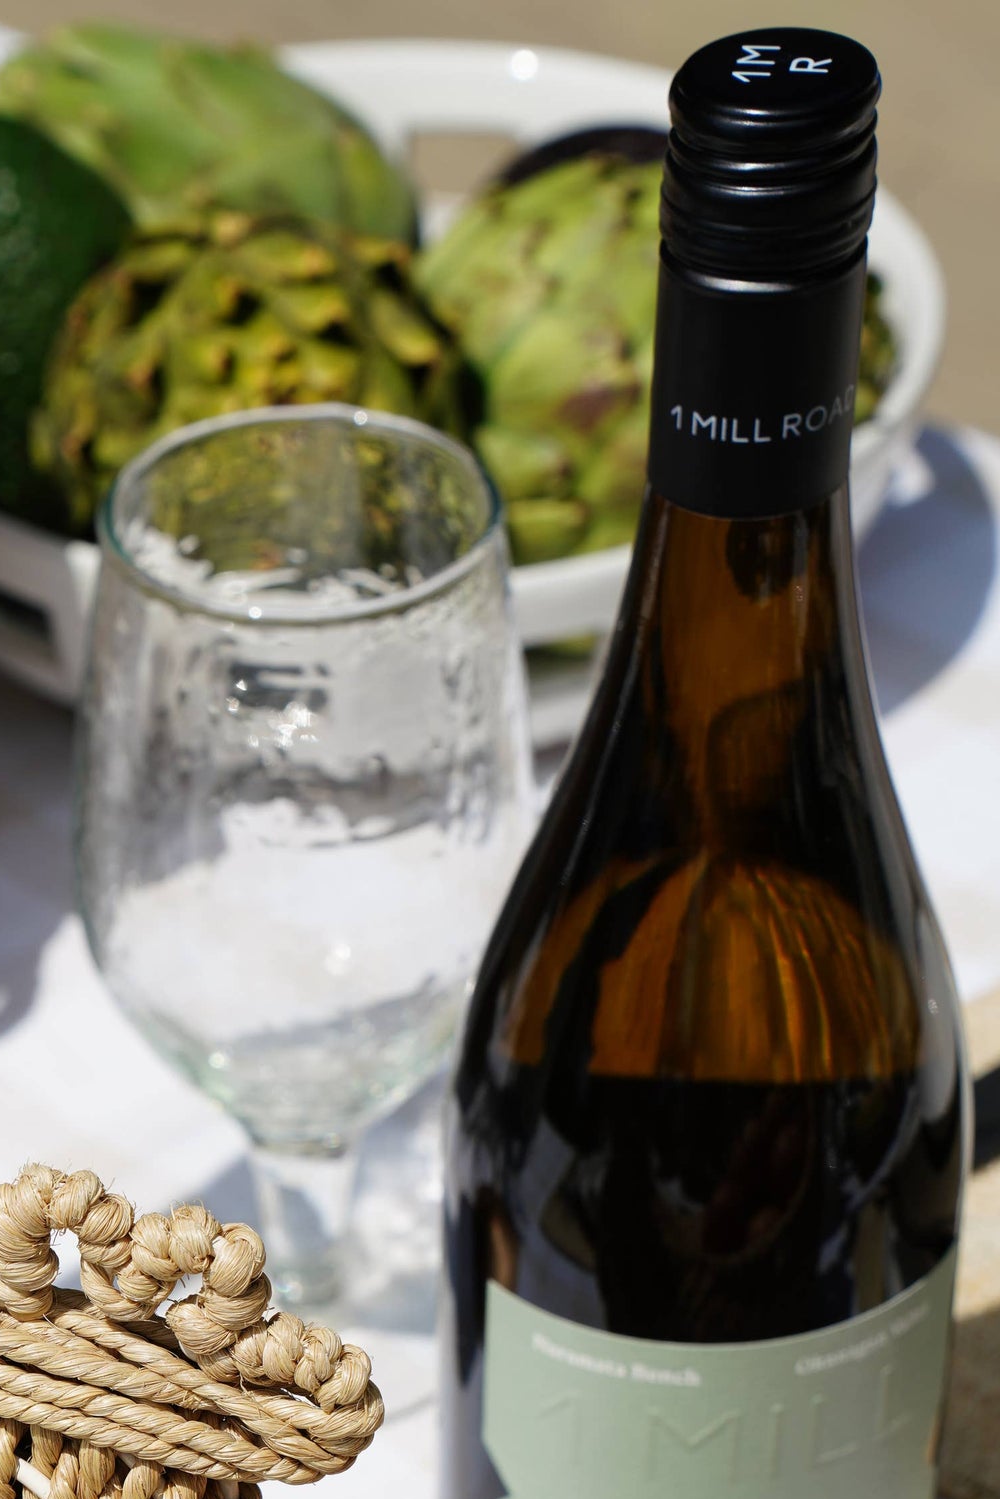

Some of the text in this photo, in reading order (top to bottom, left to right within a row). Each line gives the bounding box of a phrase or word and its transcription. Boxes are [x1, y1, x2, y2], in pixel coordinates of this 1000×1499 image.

[731, 45, 781, 83] 1M
[789, 57, 833, 73] R
[670, 404, 683, 431] 1
[691, 410, 771, 443] MILL
[534, 1362, 912, 1484] 1 MILL
